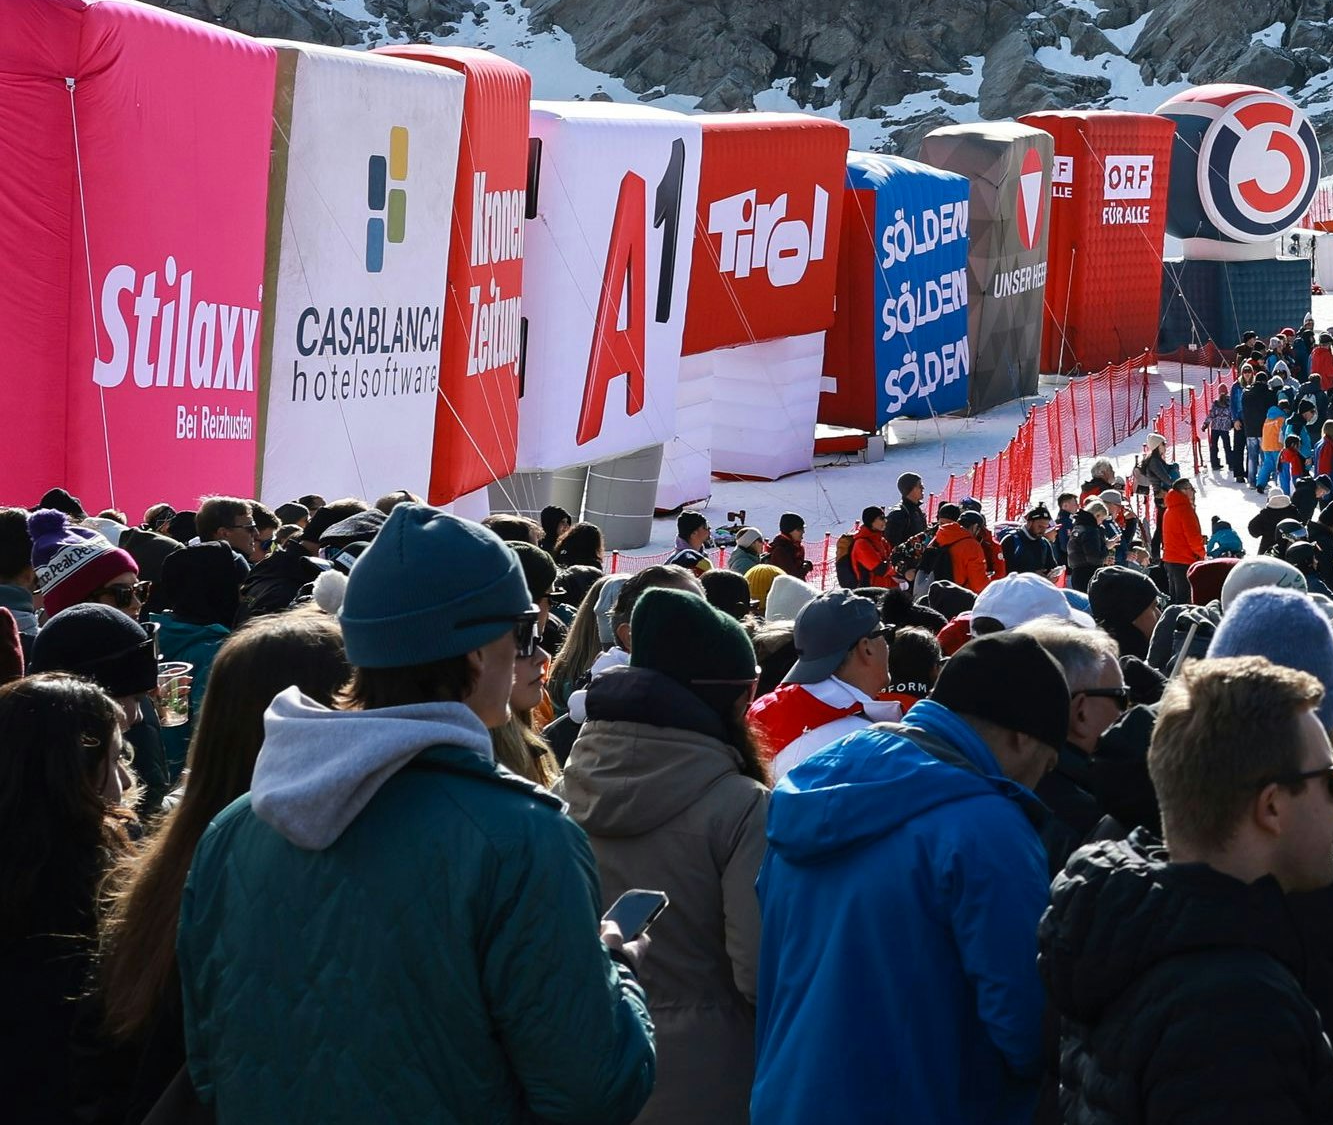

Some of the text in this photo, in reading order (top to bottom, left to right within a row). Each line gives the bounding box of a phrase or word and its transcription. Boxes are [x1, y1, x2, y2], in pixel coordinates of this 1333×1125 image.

[1052, 187, 1073, 198] LLE
[1108, 165, 1149, 190] ORF
[882, 200, 968, 270] SÖLDEN
[1102, 202, 1150, 225] FÜR ALLE
[708, 184, 829, 287] Tirol
[576, 137, 685, 444] A1
[993, 266, 1033, 300] UNSER
[882, 268, 968, 342] SÖLDEN
[296, 305, 440, 359] CASABLANCA
[292, 359, 438, 402] hotelsoftware
[884, 335, 969, 414] SÖLDEN
[176, 405, 252, 440] Bei Reizhusten
[49, 553, 74, 578] Peak
